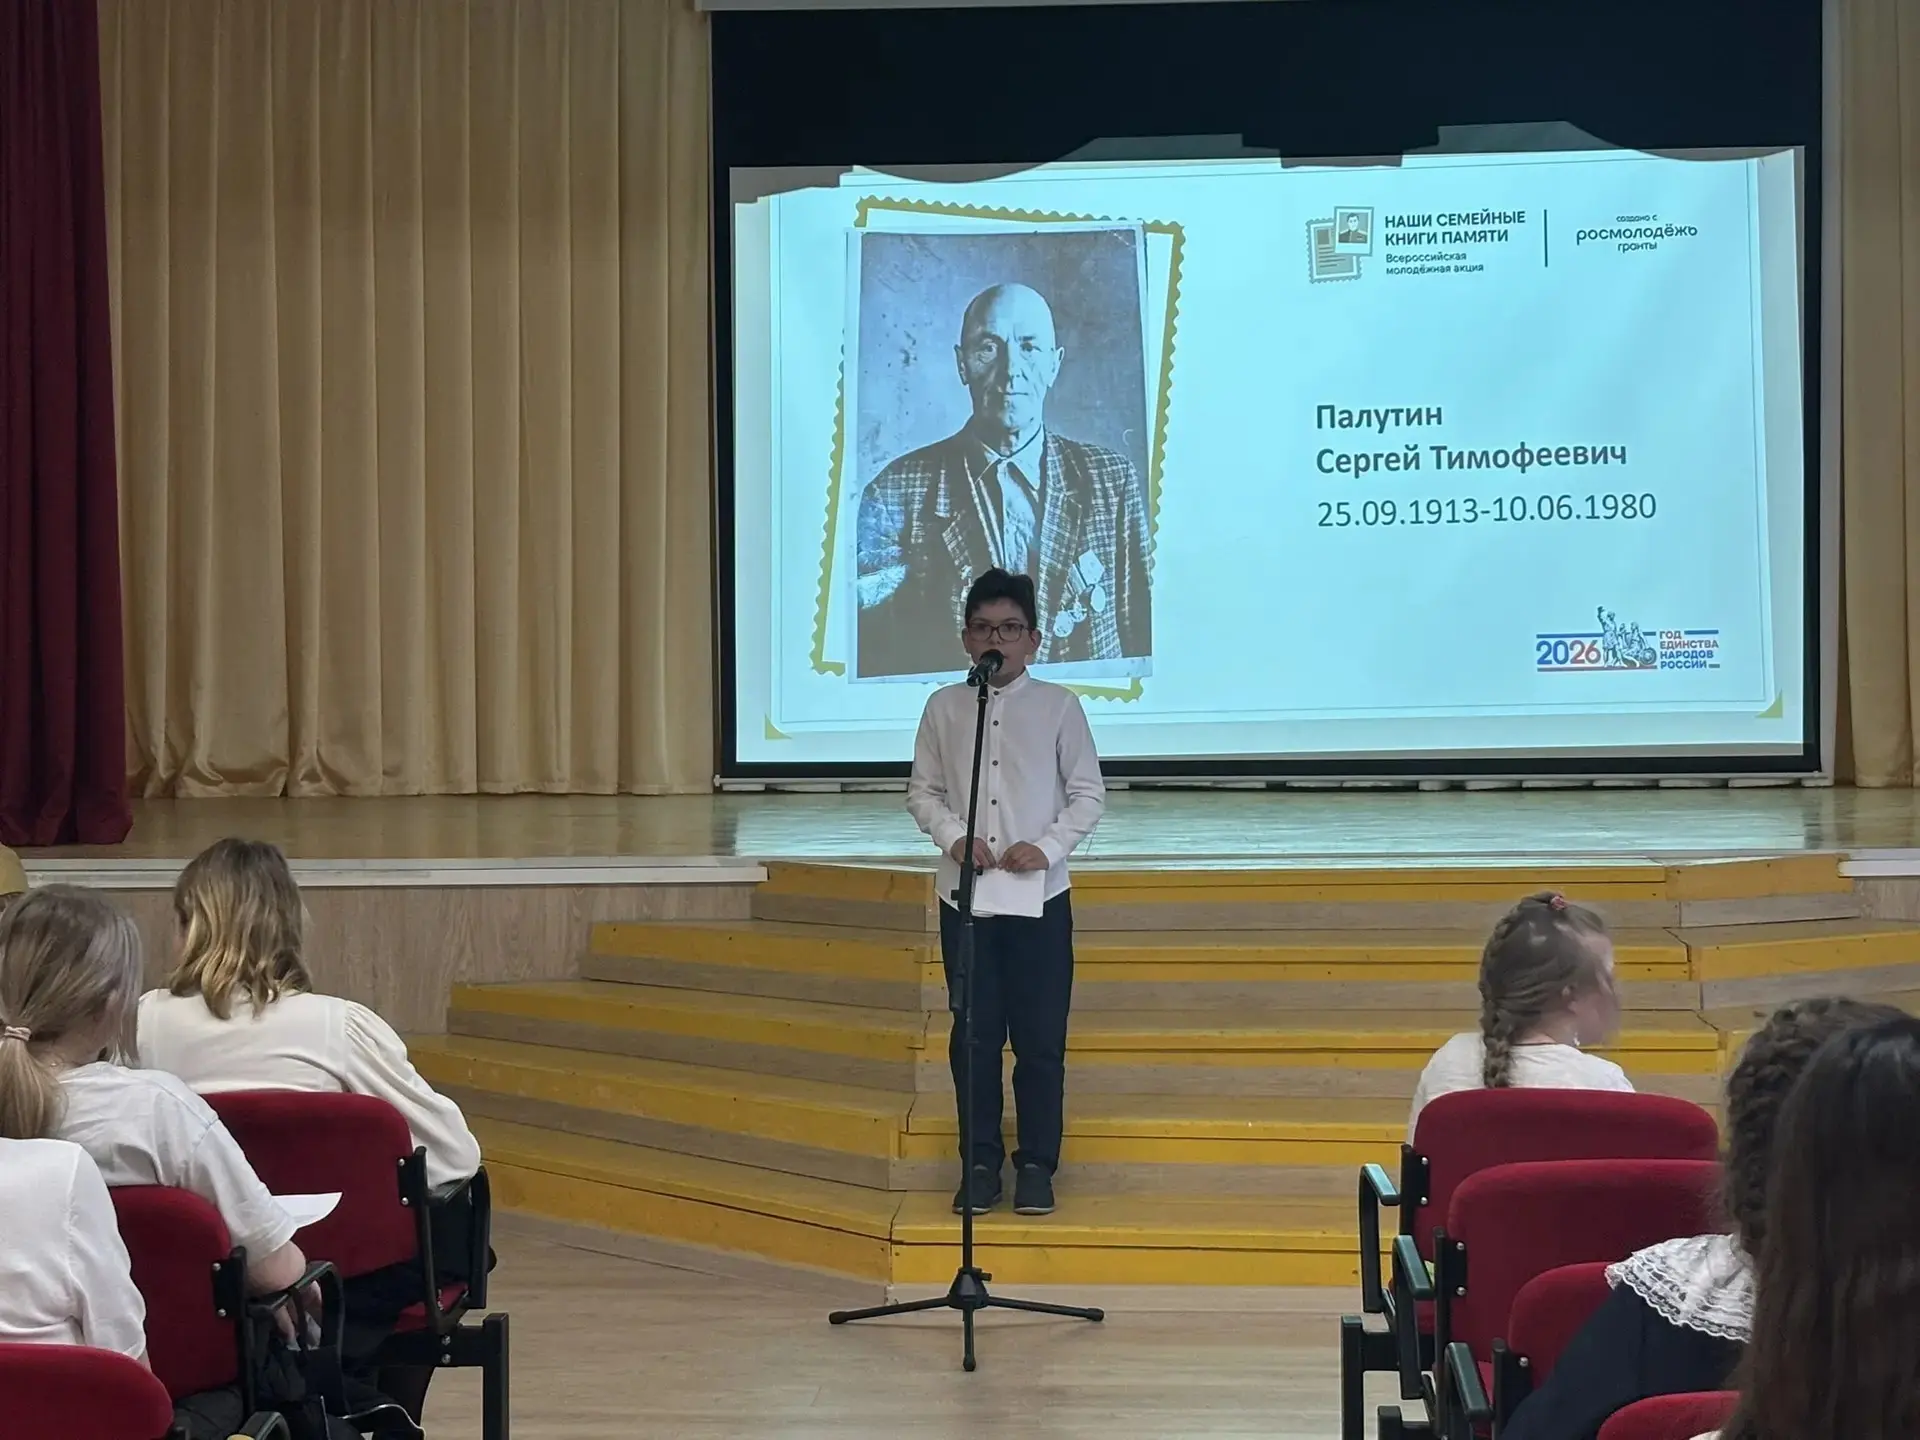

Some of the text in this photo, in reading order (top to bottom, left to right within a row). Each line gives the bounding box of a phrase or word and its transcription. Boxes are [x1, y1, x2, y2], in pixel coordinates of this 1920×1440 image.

[1384, 208, 1526, 229] НАШИ СЕМЕЙНЫЕ
[1385, 229, 1509, 246] КНИГИ ПАМЯТИ
[1576, 223, 1698, 246] росмолодёжь
[1617, 241, 1658, 253] гранты
[1385, 251, 1467, 264] Всероссийская
[1386, 263, 1484, 275] молодёжная акция
[1316, 404, 1443, 434] Палутин
[1316, 441, 1628, 479] Сергей Тимофеевич
[1317, 493, 1657, 527] 25.09.1913-10.06.1980
[1659, 630, 1682, 640] ГОД
[1536, 639, 1601, 665] 2026
[1659, 639, 1720, 650] ЕДИНСТВА
[1660, 650, 1714, 660] НАРОДОВ
[1660, 660, 1707, 670] РОССИИ
